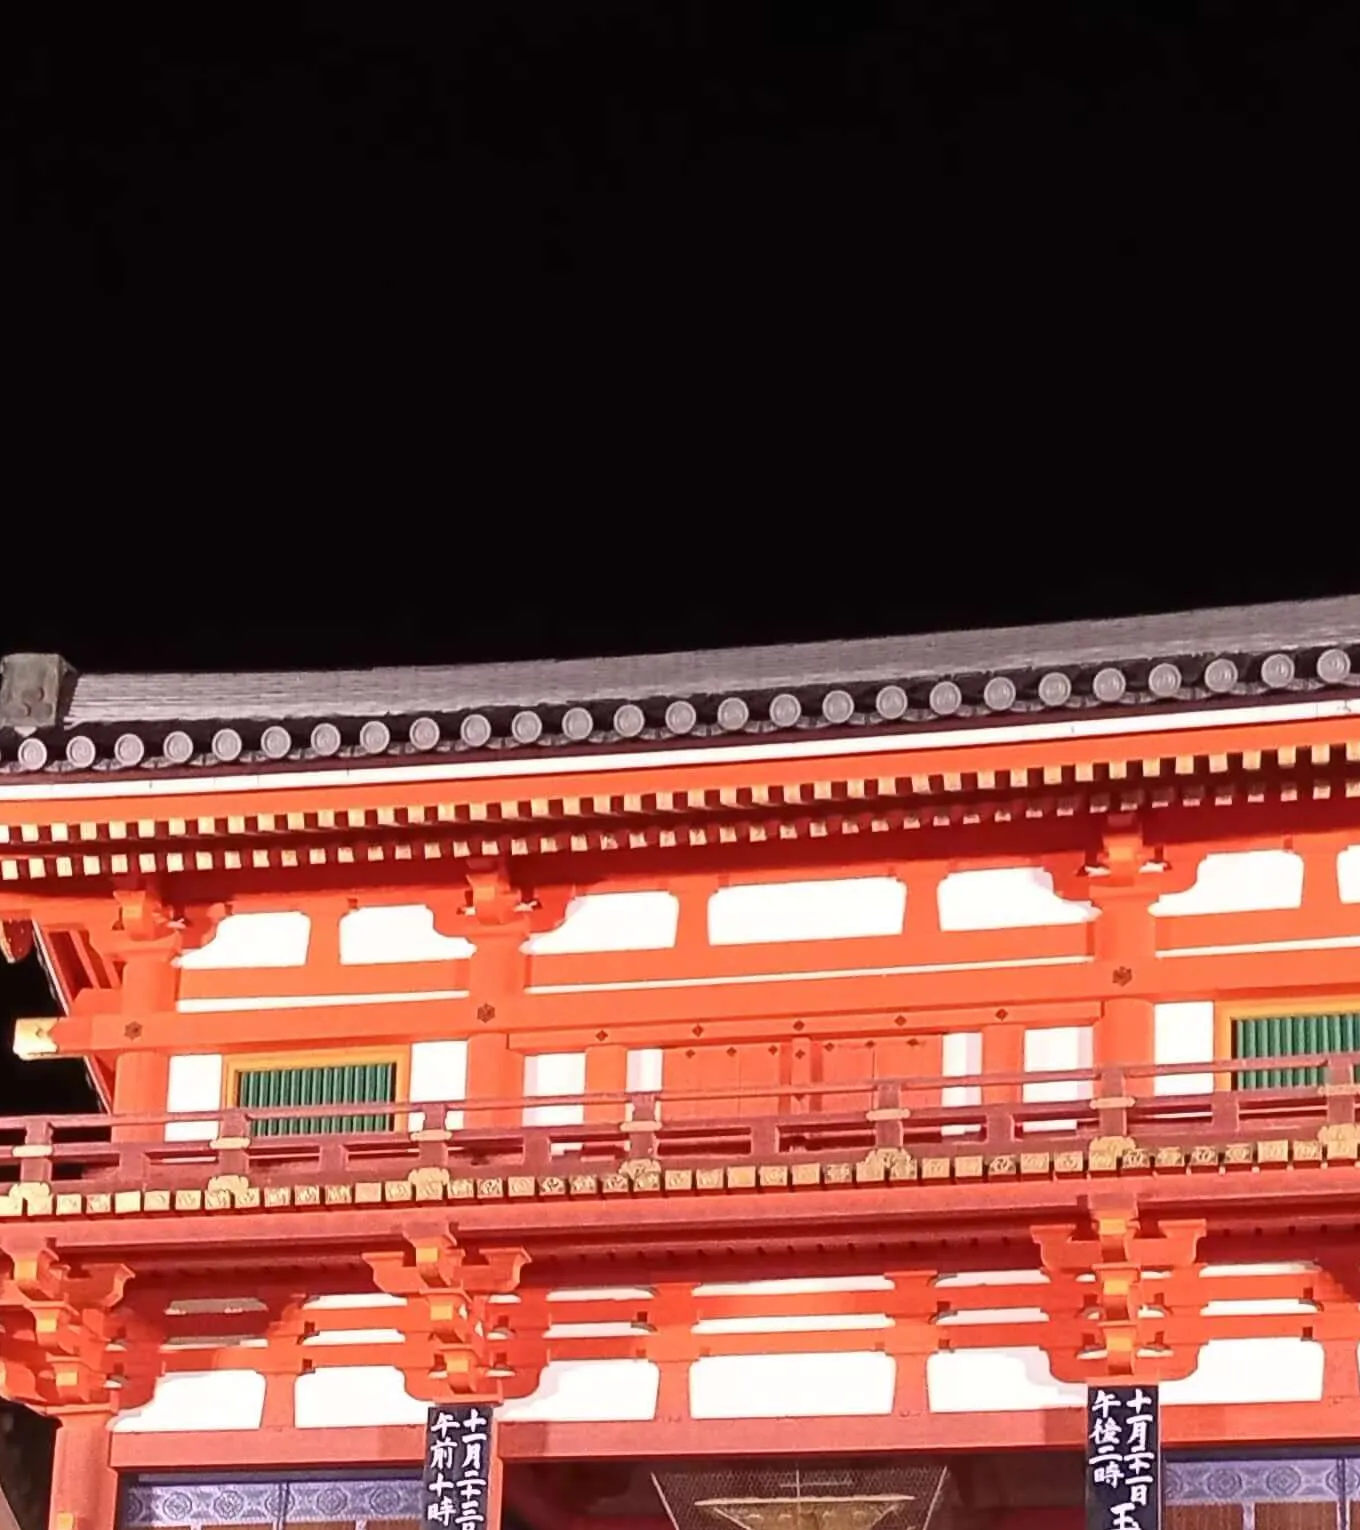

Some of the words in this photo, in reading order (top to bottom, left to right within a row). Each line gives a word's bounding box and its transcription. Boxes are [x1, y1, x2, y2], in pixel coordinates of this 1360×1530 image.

[427, 1412, 461, 1527] 午前十時
[1089, 1389, 1125, 1489] 午後二時
